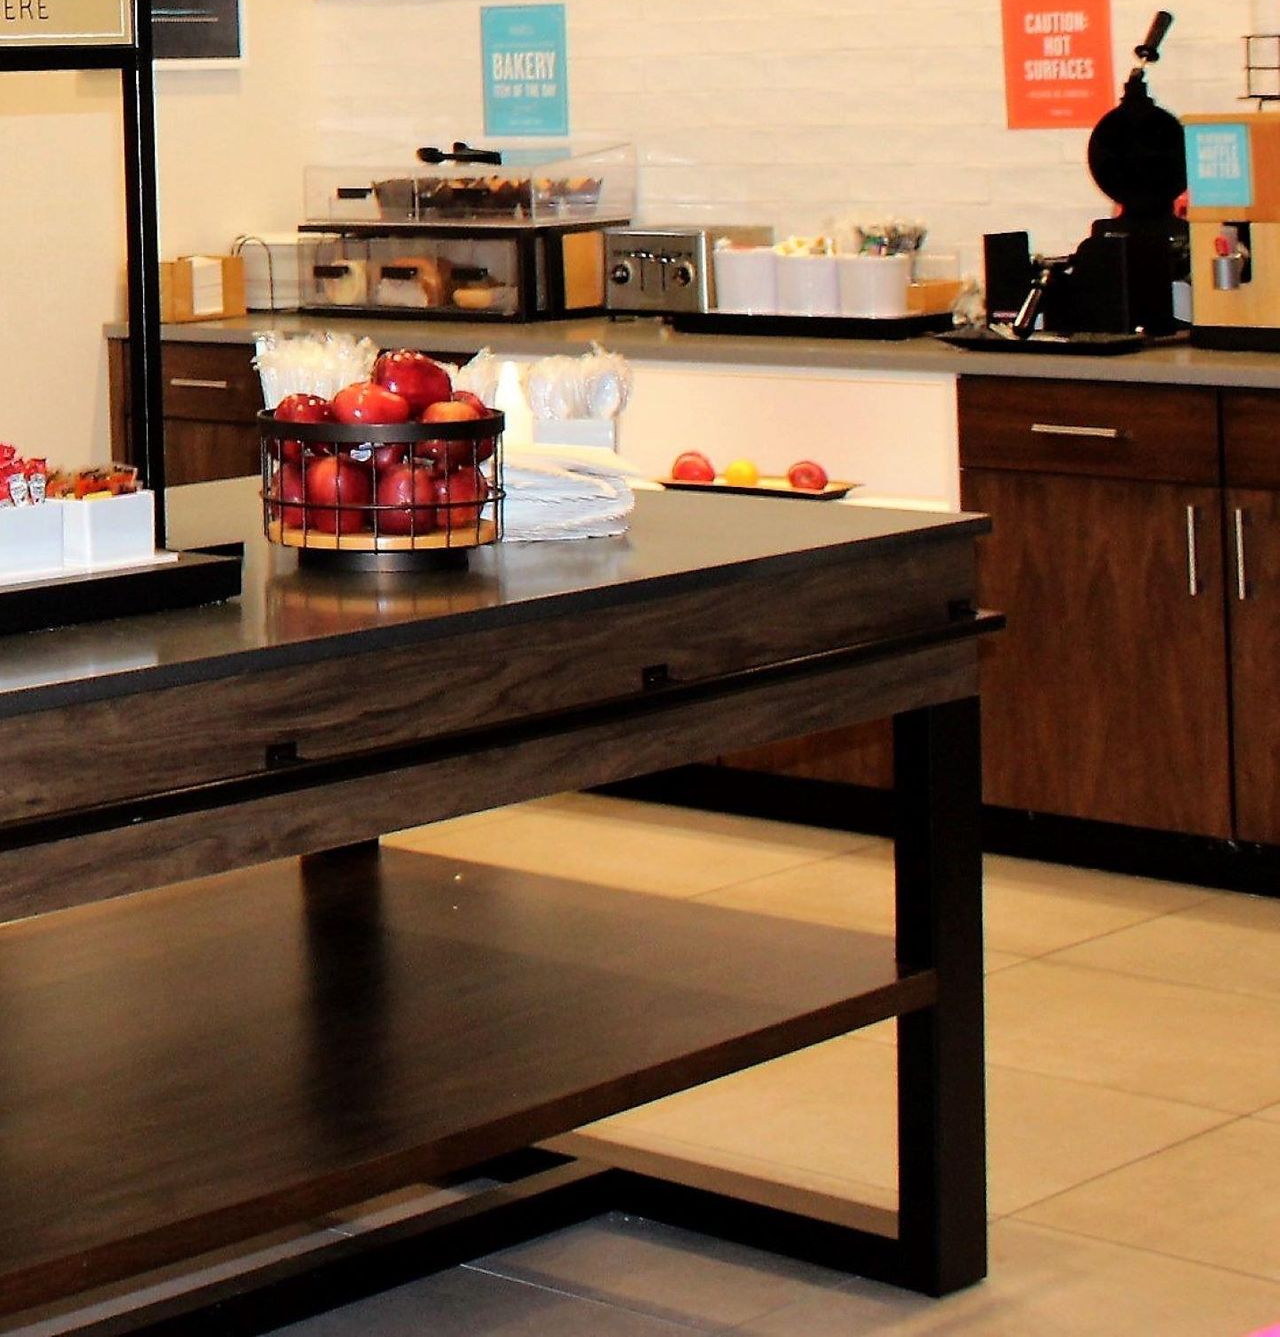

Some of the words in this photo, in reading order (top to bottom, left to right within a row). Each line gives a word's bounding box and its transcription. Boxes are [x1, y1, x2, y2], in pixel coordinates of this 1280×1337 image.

[1043, 34, 1072, 57] HOT
[493, 51, 556, 80] BAKERY
[1024, 57, 1095, 81] SURFACES
